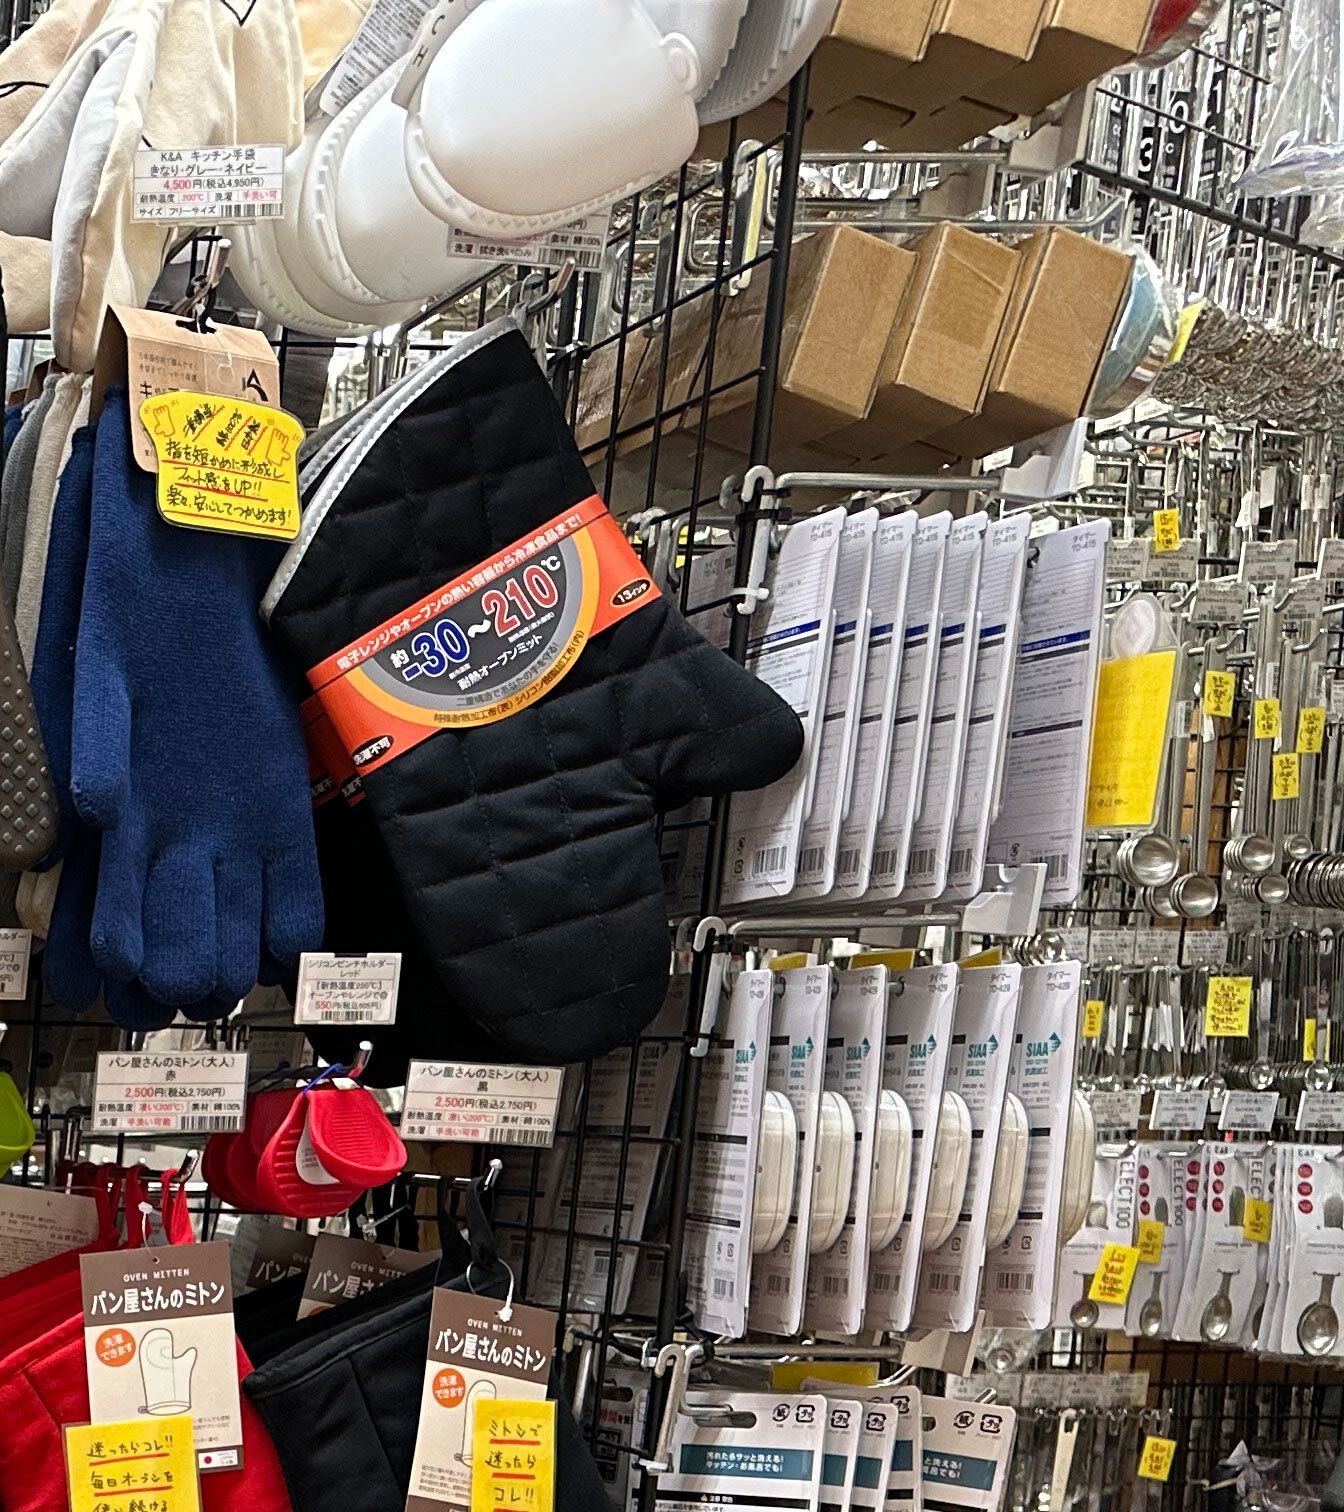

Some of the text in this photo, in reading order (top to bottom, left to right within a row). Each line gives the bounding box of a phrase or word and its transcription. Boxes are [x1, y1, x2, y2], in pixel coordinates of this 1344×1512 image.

[161, 152, 182, 162] K&A
[139, 206, 216, 216] サイズ フリーサイズ
[909, 1044, 927, 1059] SIAA
[968, 1043, 987, 1059] SIAA
[1026, 1042, 1049, 1058] SIAA
[122, 1268, 190, 1283] OVEN MITTEN
[90, 1281, 225, 1316] パン屋さんのミトン
[467, 1318, 488, 1331] OVEN
[435, 1328, 546, 1372] パン屋さんのミトン
